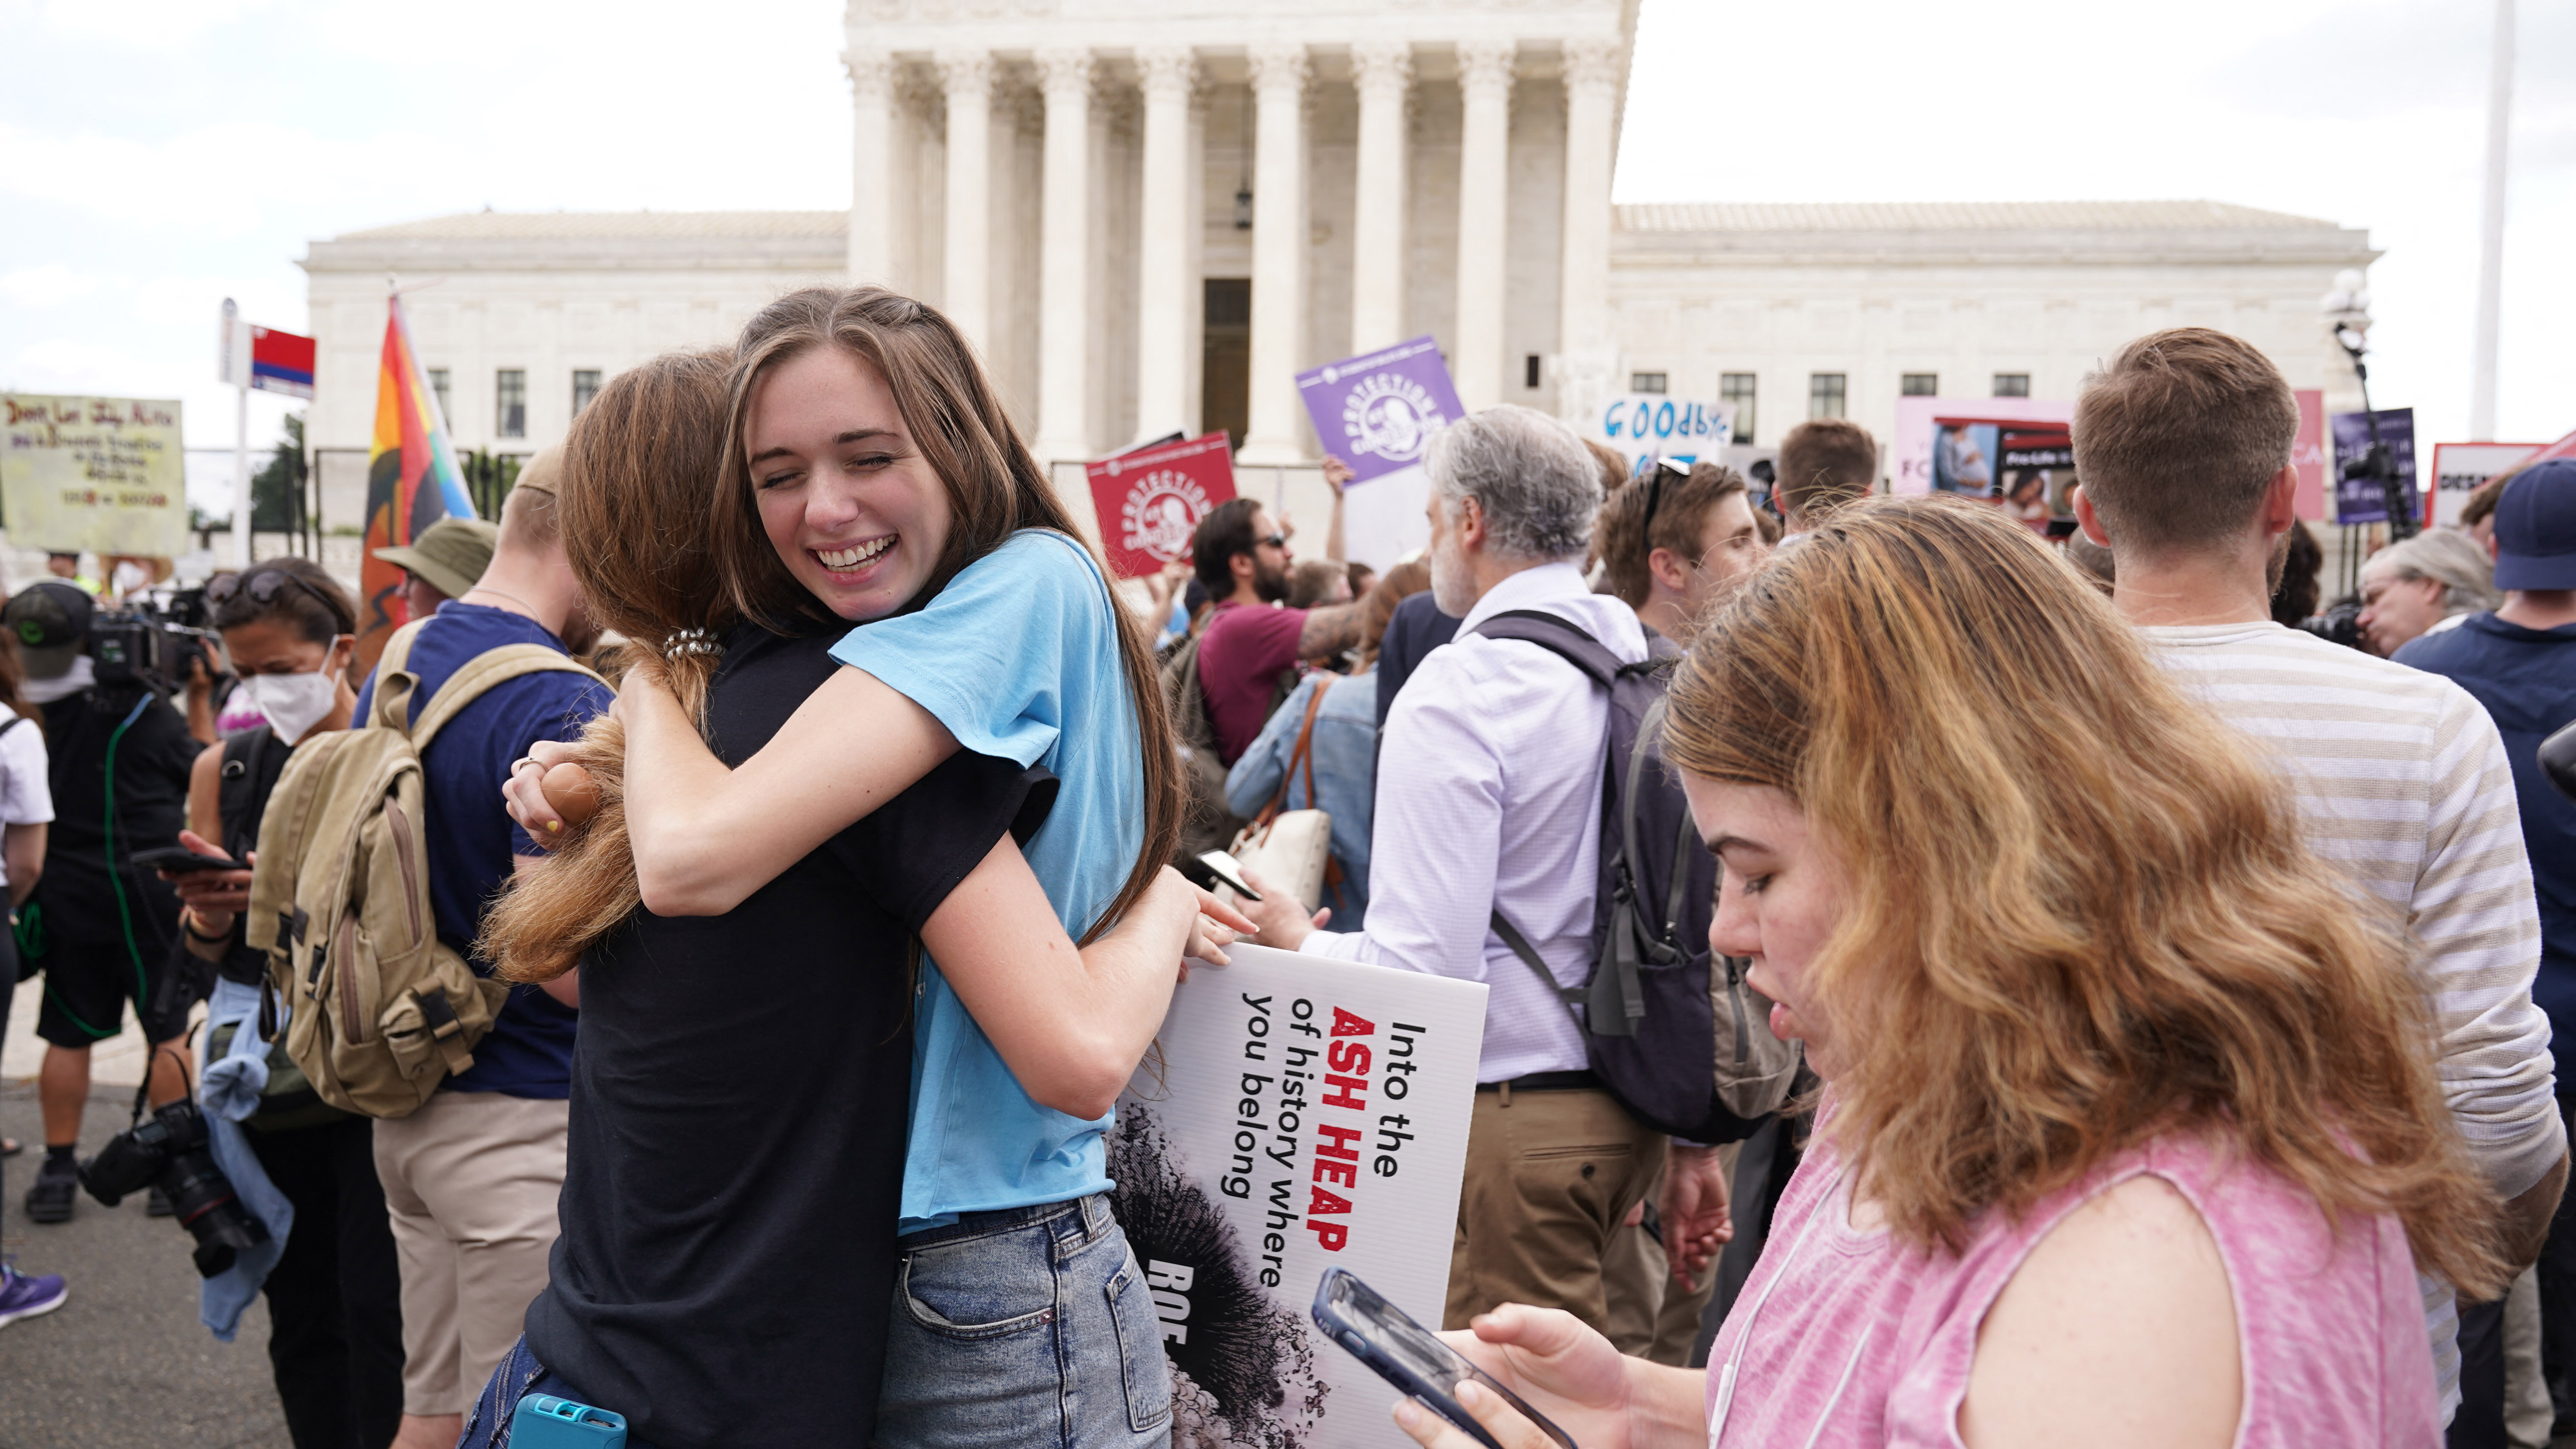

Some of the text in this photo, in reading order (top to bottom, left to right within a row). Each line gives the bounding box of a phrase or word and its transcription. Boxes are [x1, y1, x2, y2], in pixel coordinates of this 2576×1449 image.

[1342, 372, 1437, 437] PROTECTION
[1121, 468, 1213, 533] PROTECTION
[1221, 992, 1274, 1199] you belong
[1259, 998, 1321, 1288] of history where
[1306, 1005, 1376, 1252] ASH HEAP
[1373, 1022, 1426, 1178] Into the
[1147, 1258, 1194, 1345] ROE
